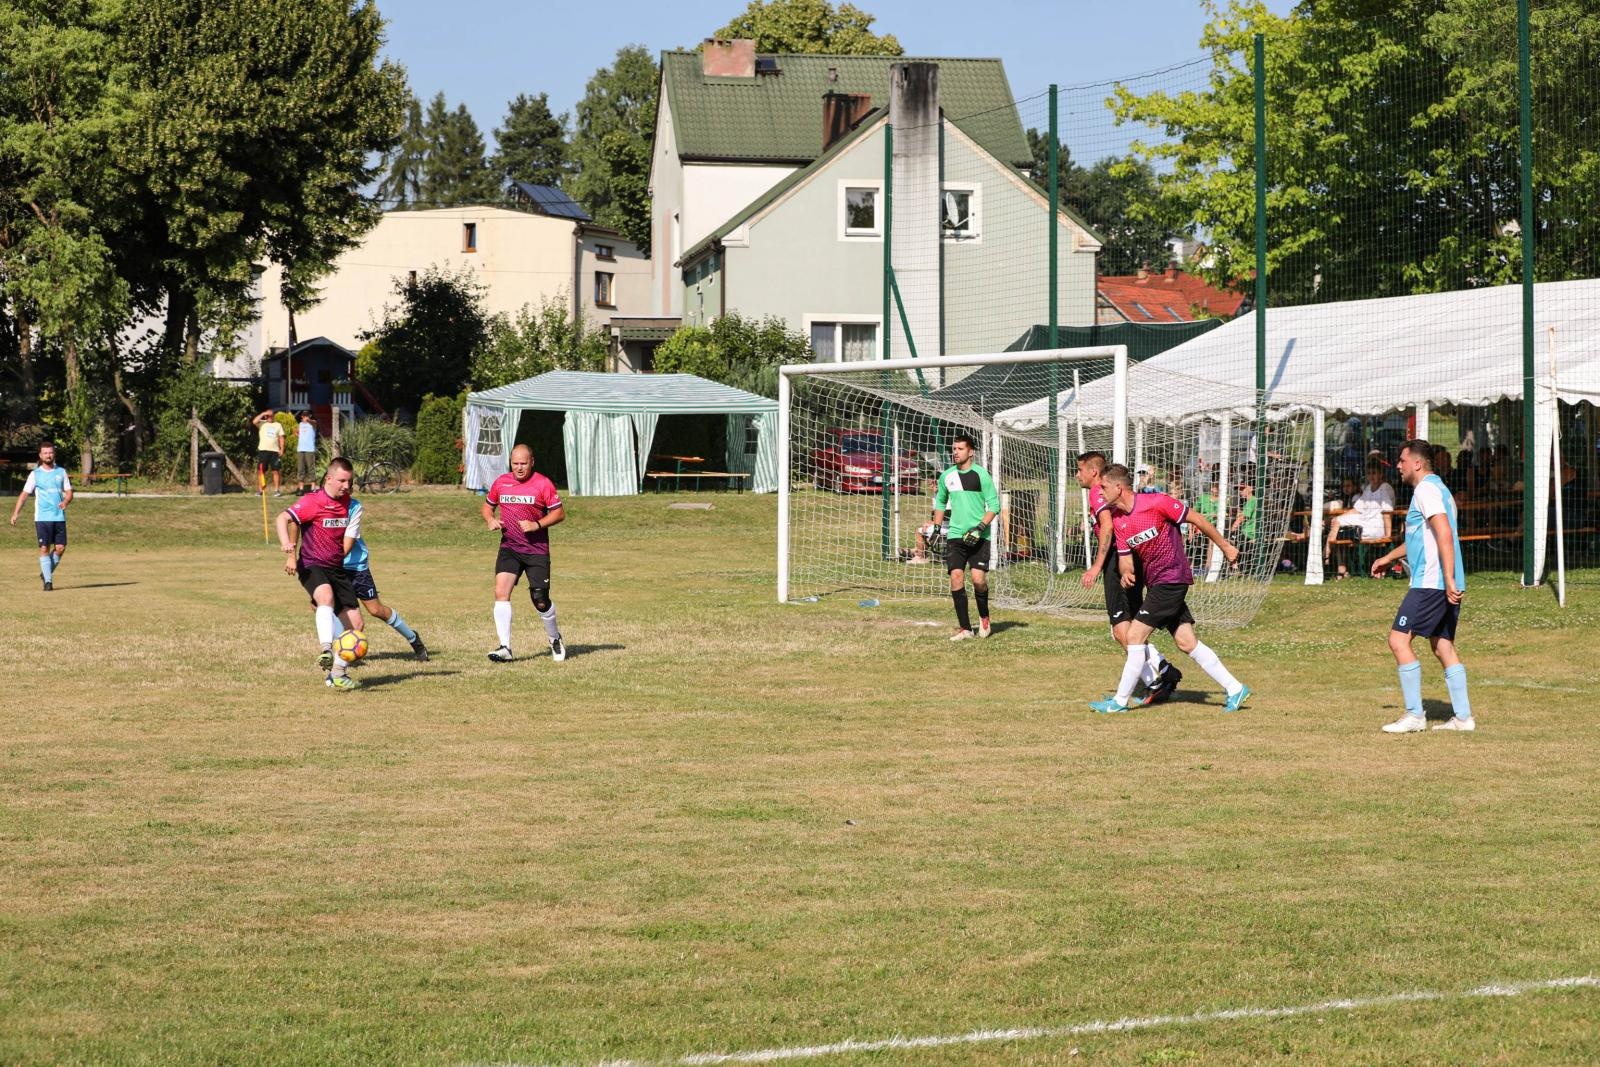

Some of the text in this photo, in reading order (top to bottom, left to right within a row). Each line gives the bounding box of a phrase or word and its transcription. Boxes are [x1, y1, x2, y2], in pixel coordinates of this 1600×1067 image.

[500, 495, 533, 504] PROSAT
[324, 519, 350, 527] PROSA
[1128, 528, 1157, 547] ROSAT
[1398, 615, 1408, 627] 6
